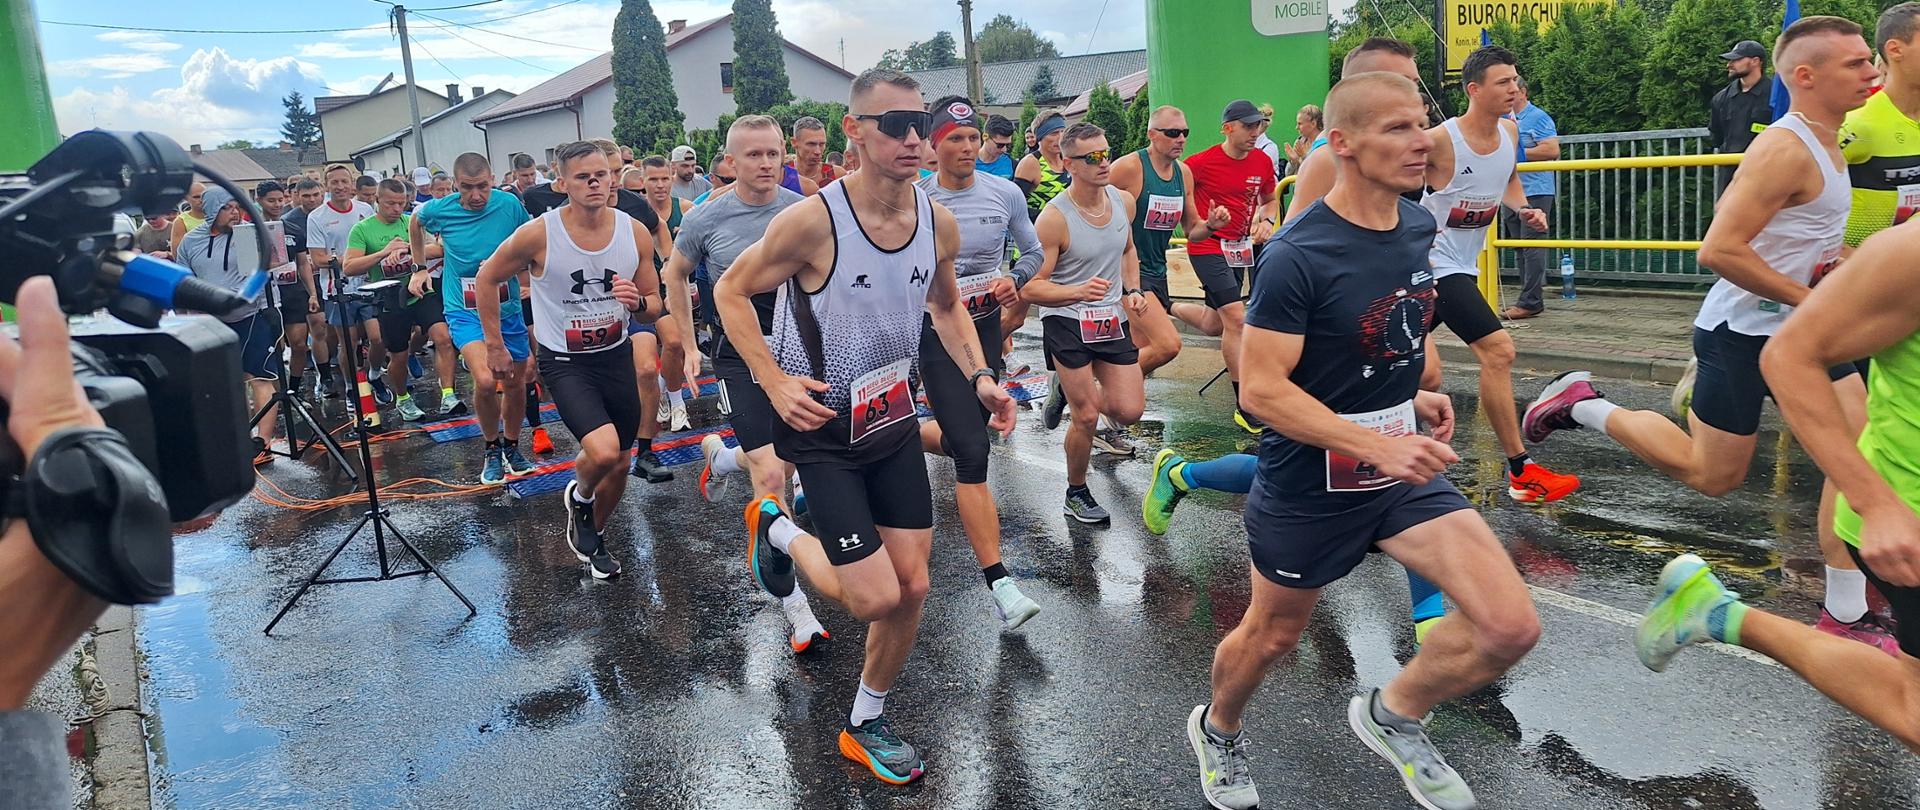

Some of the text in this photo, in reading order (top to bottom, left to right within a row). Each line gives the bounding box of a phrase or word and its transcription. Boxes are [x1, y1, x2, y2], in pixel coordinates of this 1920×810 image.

[1275, 2, 1322, 19] MOBILE
[1458, 4, 1506, 25] BIURO
[1460, 200, 1469, 208] 11
[1153, 211, 1175, 224] 214
[1463, 211, 1484, 224] 81
[1230, 250, 1243, 262] 98
[1085, 310, 1094, 319] 11
[571, 319, 582, 329] 11
[1093, 319, 1111, 335] 79
[581, 328, 608, 345] 59
[858, 386, 866, 402] 11
[866, 391, 890, 422] 63
[1354, 460, 1378, 479] 4
